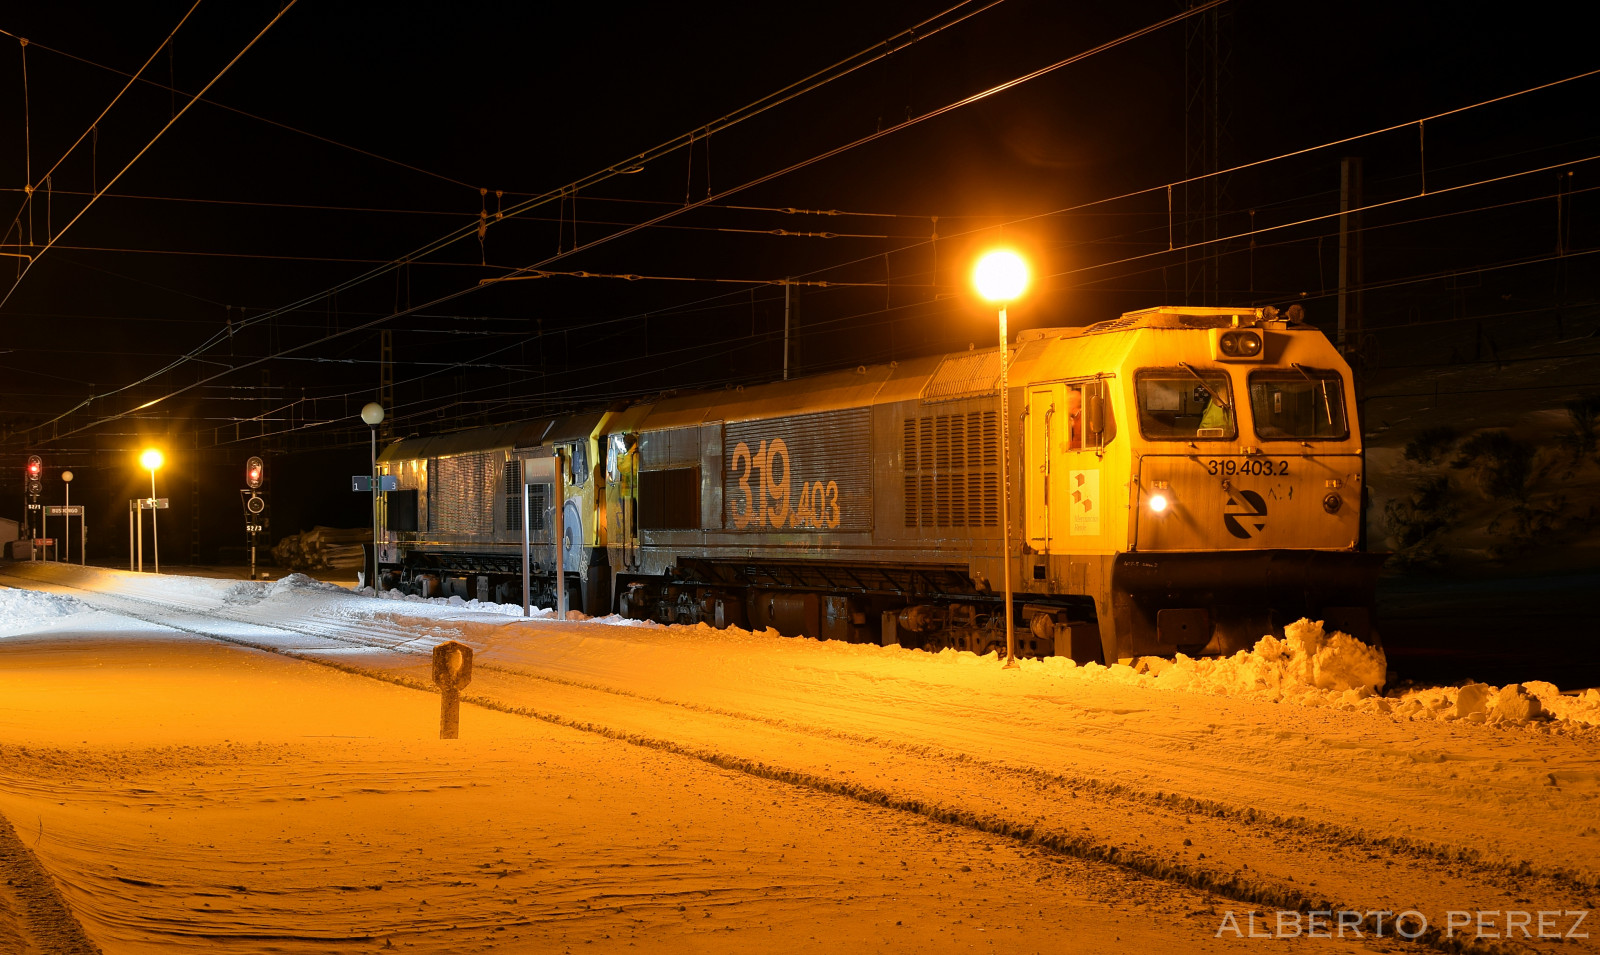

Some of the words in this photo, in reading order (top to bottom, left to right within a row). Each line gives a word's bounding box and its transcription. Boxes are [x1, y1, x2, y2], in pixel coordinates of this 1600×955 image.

[1208, 460, 1289, 476] 319.403.2
[353, 483, 359, 491] 1
[391, 482, 397, 490] 3
